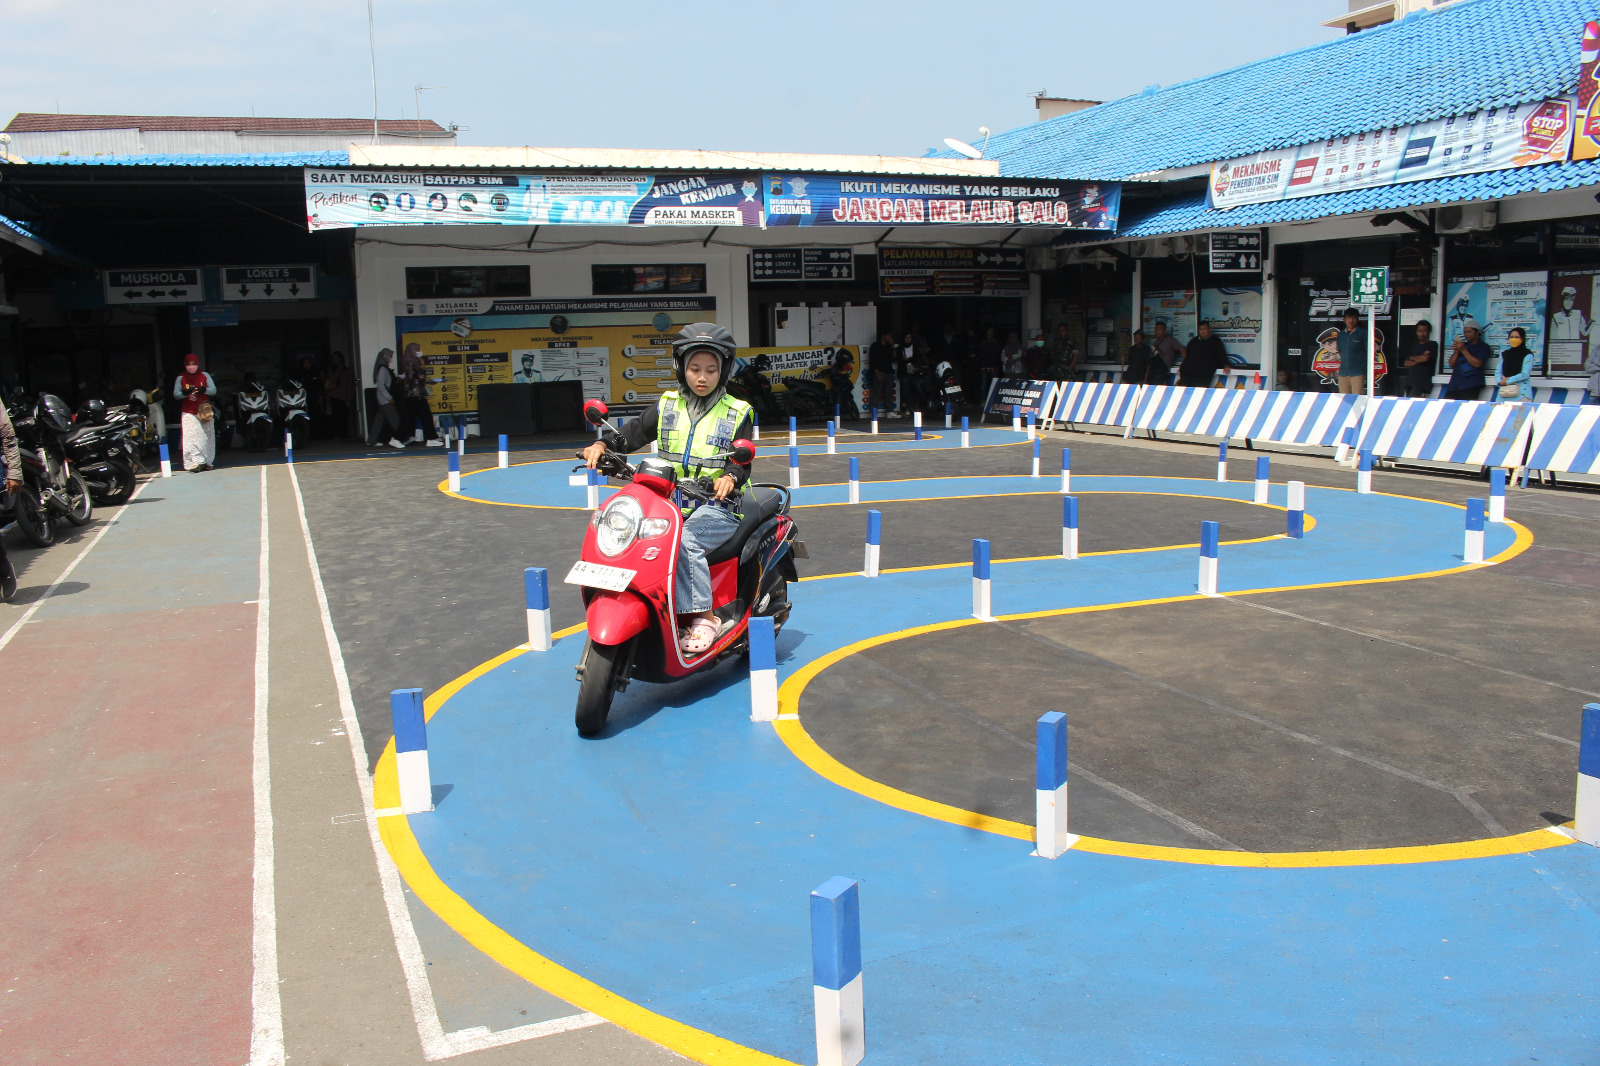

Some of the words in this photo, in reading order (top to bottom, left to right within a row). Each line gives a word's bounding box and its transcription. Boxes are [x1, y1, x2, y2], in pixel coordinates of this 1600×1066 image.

[1532, 116, 1564, 130] STOP
[1232, 159, 1282, 179] MEKANISME
[311, 173, 346, 184] SAAT
[350, 173, 423, 184] MEMASUKI
[425, 175, 475, 185] SATPAS
[478, 176, 504, 185] SIM
[1229, 176, 1265, 190] PENERBITAN
[1266, 174, 1279, 185] SIM
[652, 176, 707, 199] JANGAN
[840, 182, 877, 194] IKUTI
[881, 183, 961, 197] MEKANISME
[963, 185, 999, 197] YANG
[1002, 186, 1060, 198] BERLAKU
[310, 191, 358, 209] Pastikan
[679, 183, 737, 206] KENDOR
[655, 210, 687, 219] PAKAI
[691, 210, 736, 219] MASKER
[770, 204, 812, 215] KEBUMEN
[833, 197, 925, 223] JANGAN
[928, 199, 1014, 224] MELALUI
[1017, 200, 1068, 225] CALO
[883, 249, 945, 259] PELAYANAN
[946, 249, 974, 259] BPKB
[120, 272, 186, 284] MUSHOLA
[247, 268, 280, 278] LOKET
[282, 268, 290, 278] 5
[495, 304, 524, 312] PAHAMI
[785, 350, 823, 361] LANCAR
[442, 393, 448, 401] 8
[574, 563, 588, 573] AA
